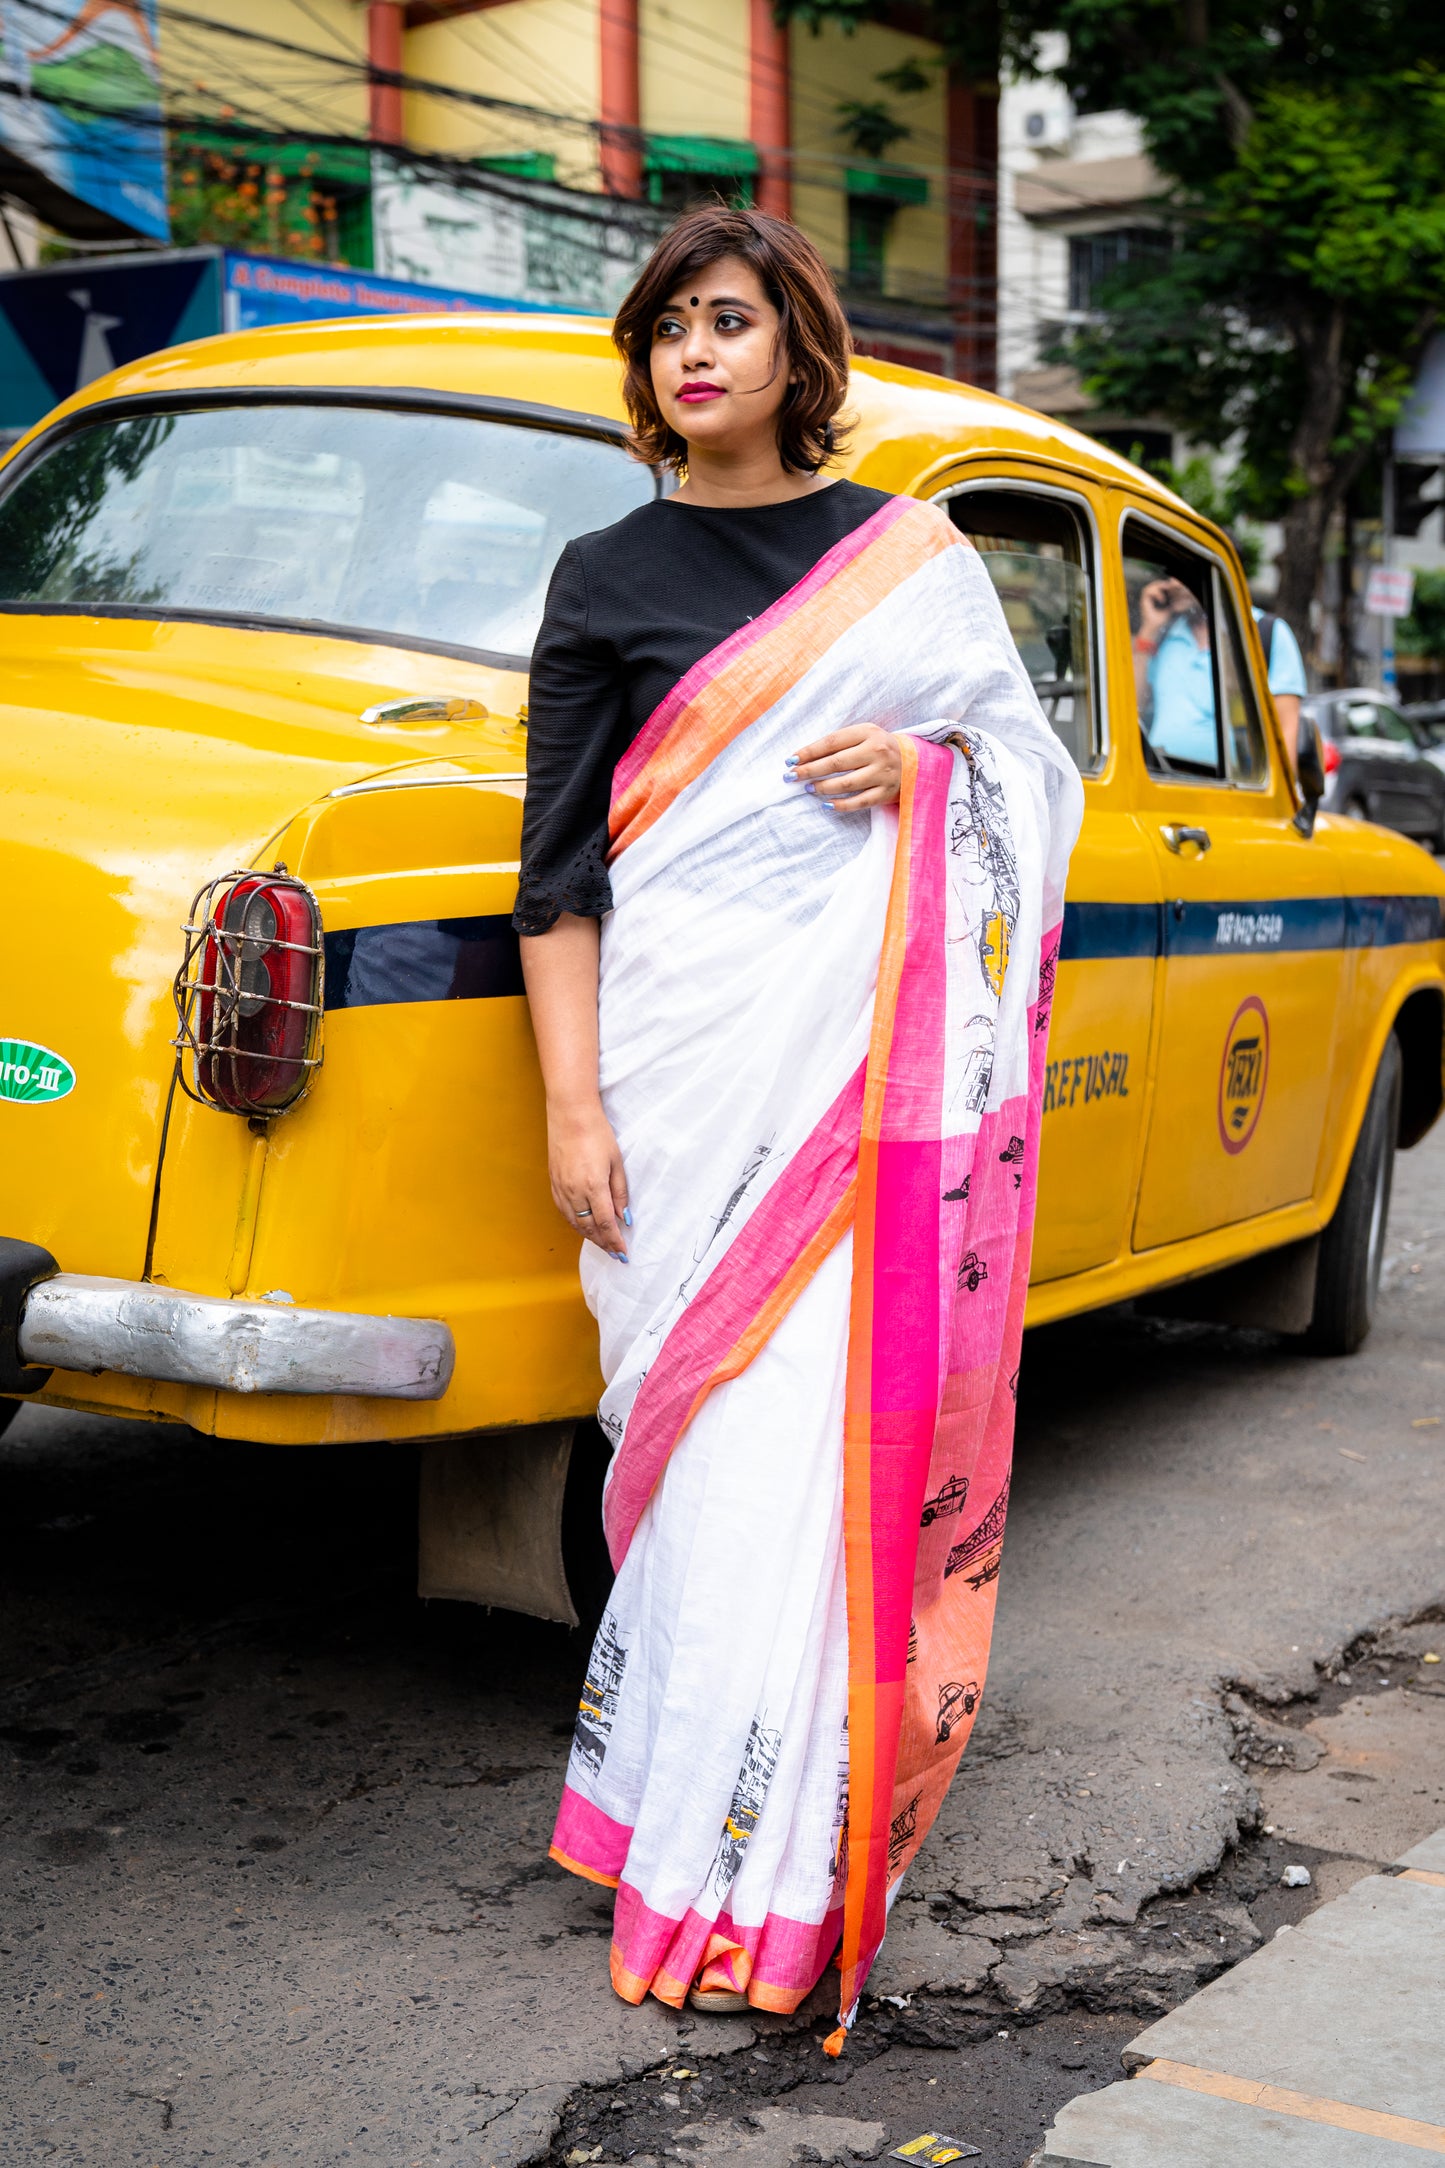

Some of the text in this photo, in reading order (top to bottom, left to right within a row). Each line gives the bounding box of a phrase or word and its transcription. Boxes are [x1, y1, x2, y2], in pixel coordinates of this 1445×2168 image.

[232, 263, 251, 287] A
[254, 266, 352, 302] Complete
[1043, 1050, 1129, 1115] REFUSAL
[1227, 1036, 1262, 1099] TAXI
